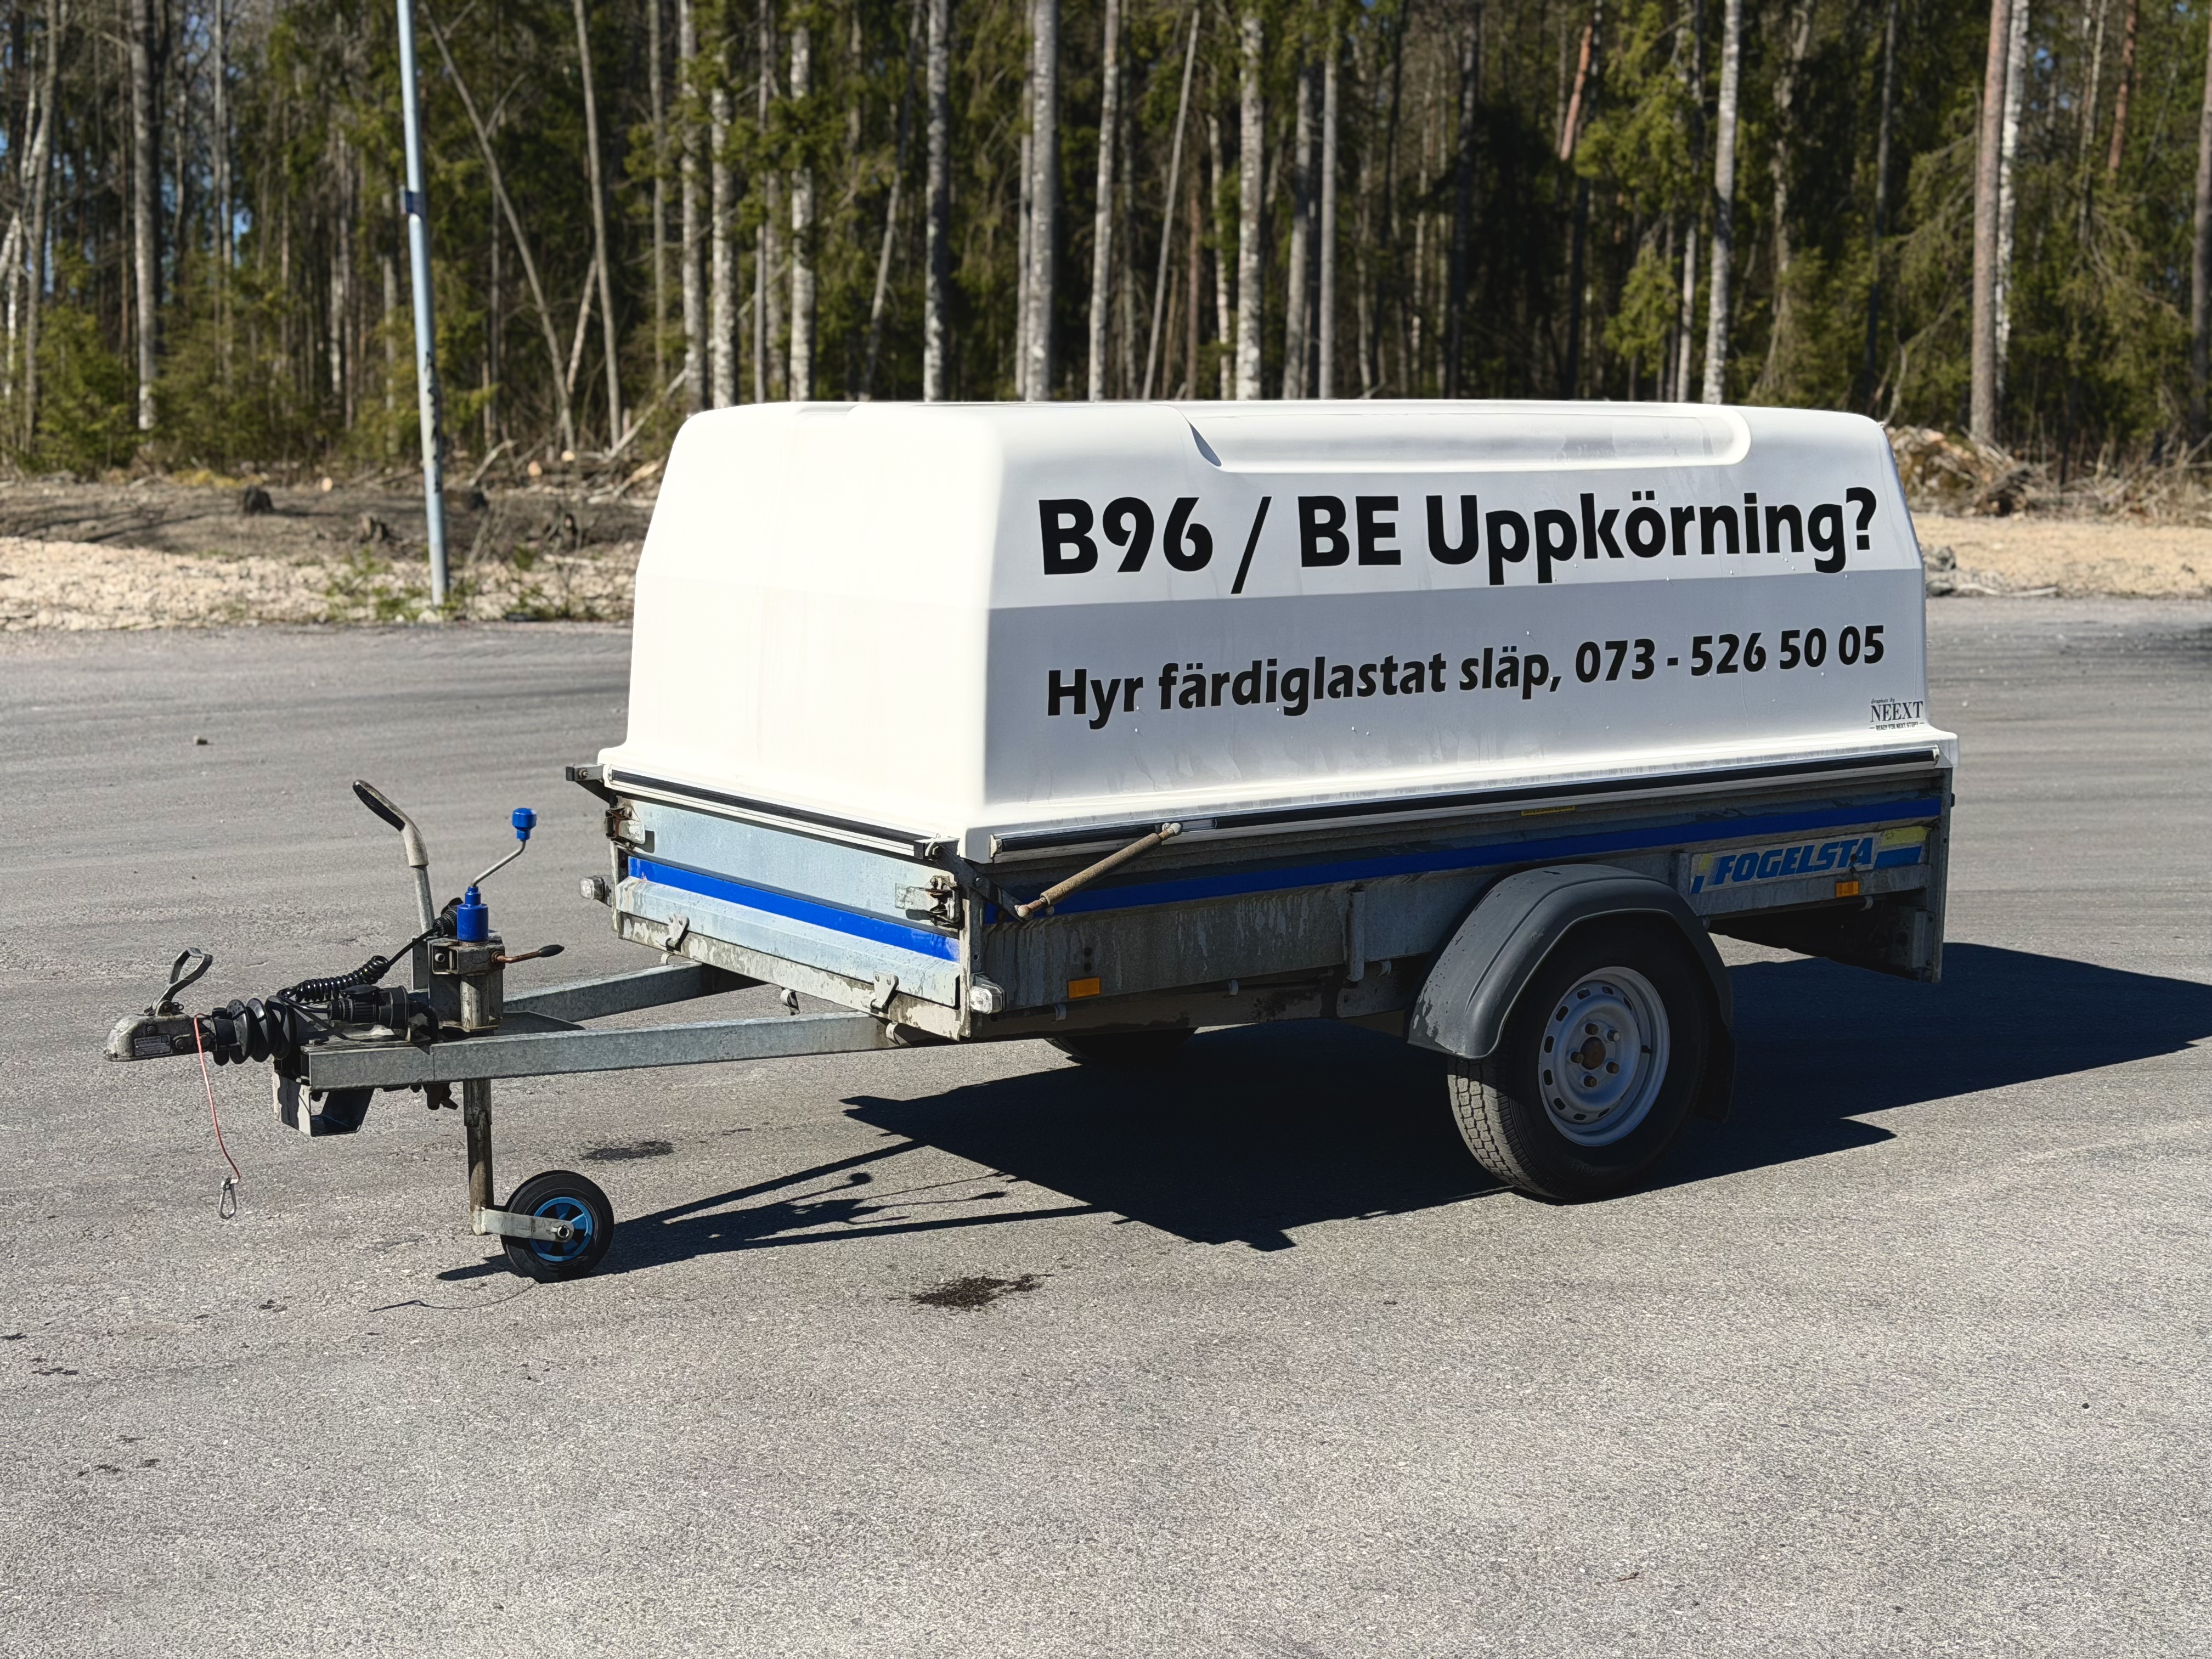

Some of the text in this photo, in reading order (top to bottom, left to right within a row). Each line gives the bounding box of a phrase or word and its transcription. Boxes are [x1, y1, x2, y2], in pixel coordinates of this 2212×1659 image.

[1039, 487, 1877, 594] B96 / BE Uppkörning?
[1047, 669, 1144, 730] Hyr
[1158, 652, 1447, 716] färdiglastat
[1459, 644, 1562, 700] släp,
[1575, 639, 1655, 683] 073
[1691, 632, 1767, 676] 526
[1780, 628, 1827, 670] 50
[1838, 625, 1884, 665] 05
[1870, 701, 1923, 723] NEEXT
[1713, 837, 1874, 885] FOGELSTA
